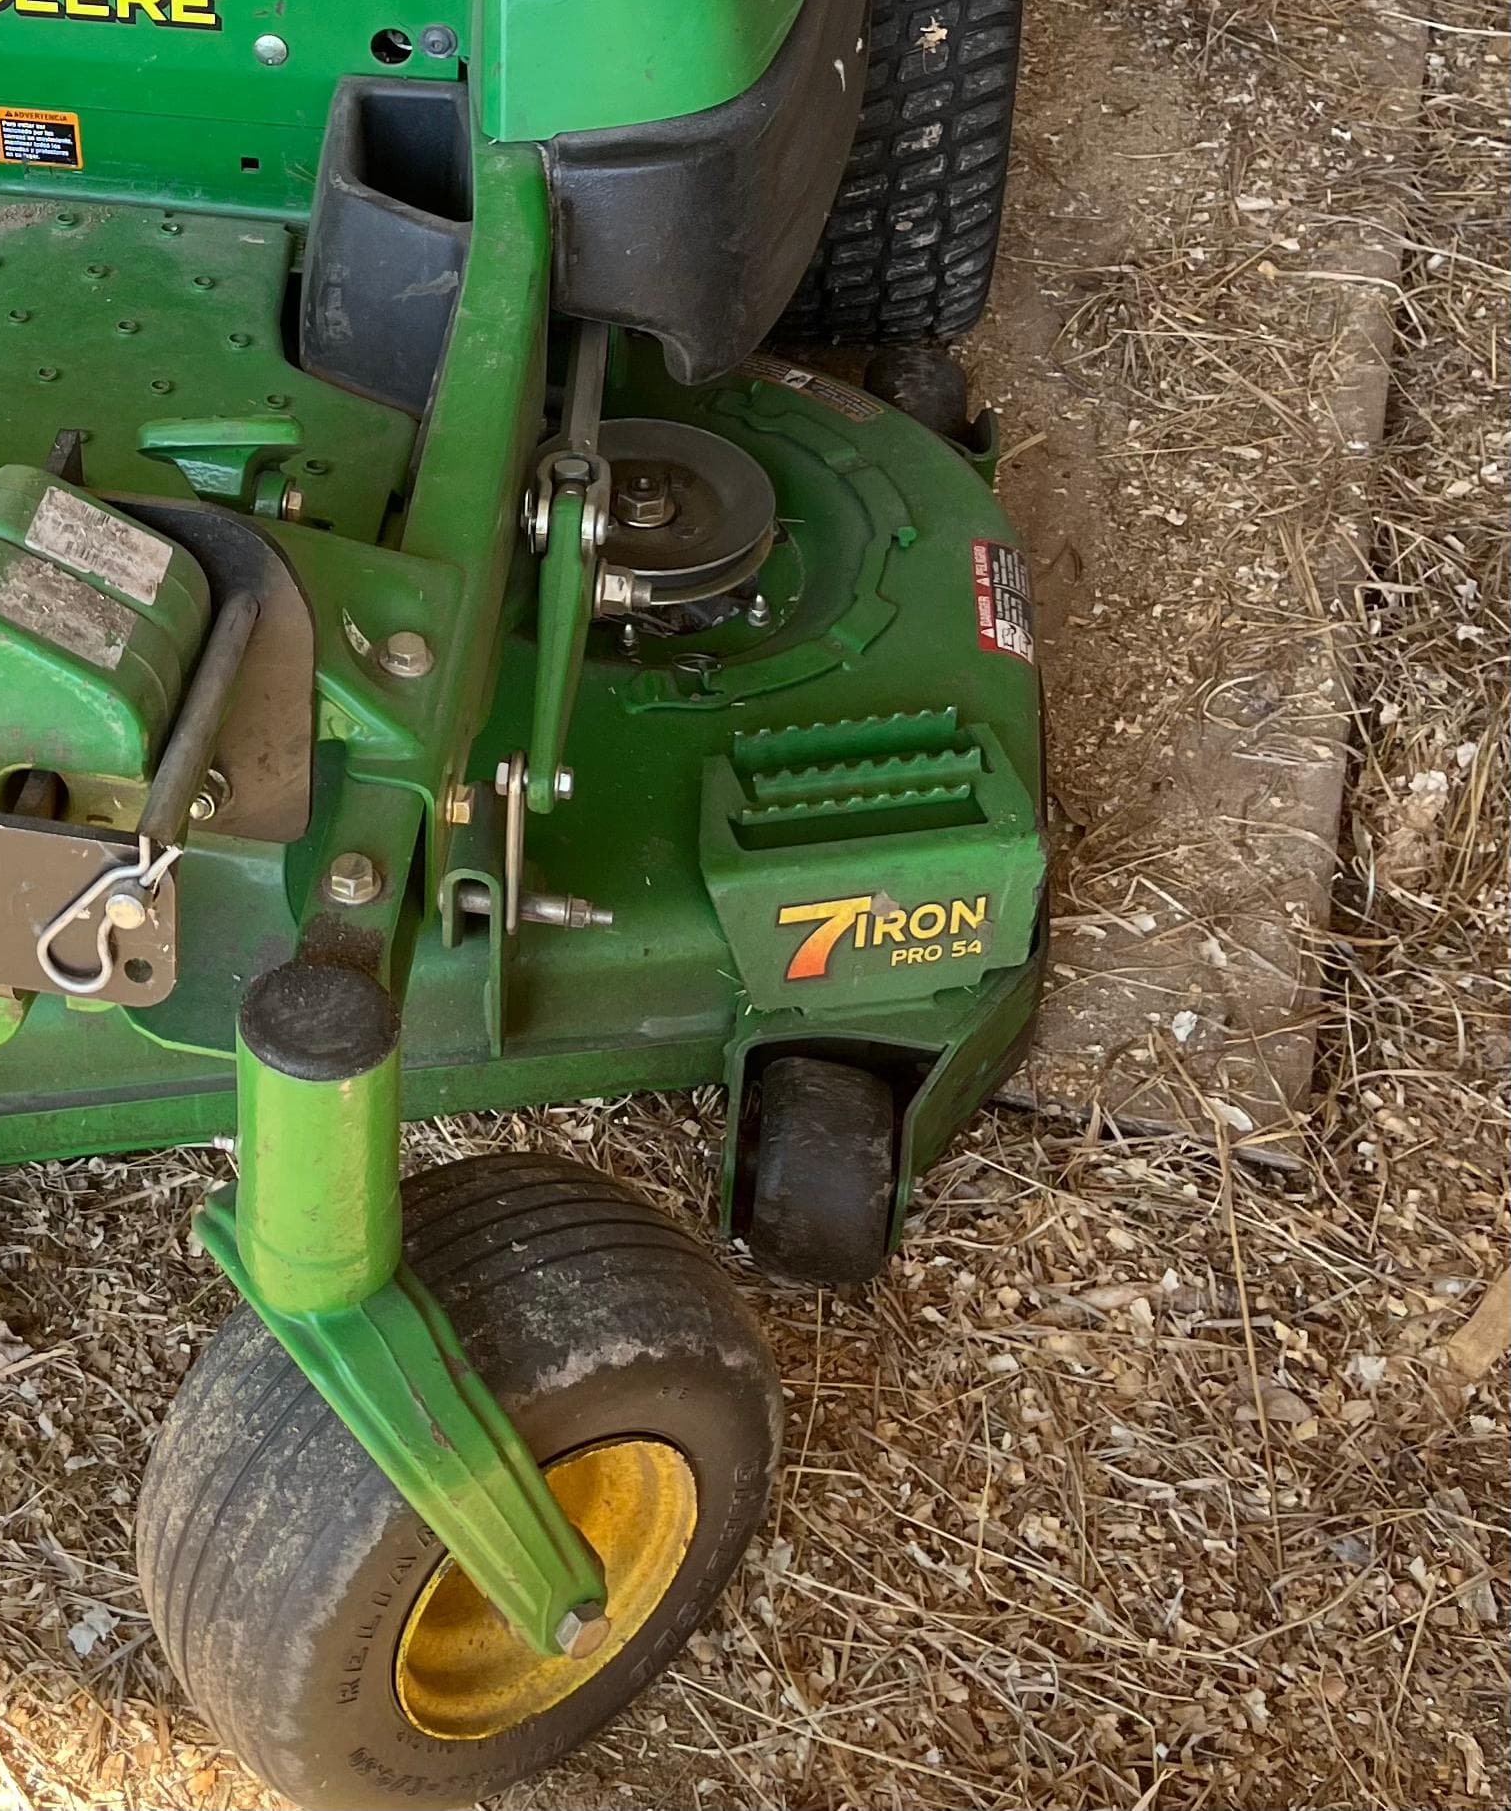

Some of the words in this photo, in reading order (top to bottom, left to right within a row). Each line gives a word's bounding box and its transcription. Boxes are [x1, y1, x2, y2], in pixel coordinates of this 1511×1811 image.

[14, 112, 67, 121] ADVERTENCIA
[891, 943, 943, 967] PRO
[951, 939, 982, 958] 54
